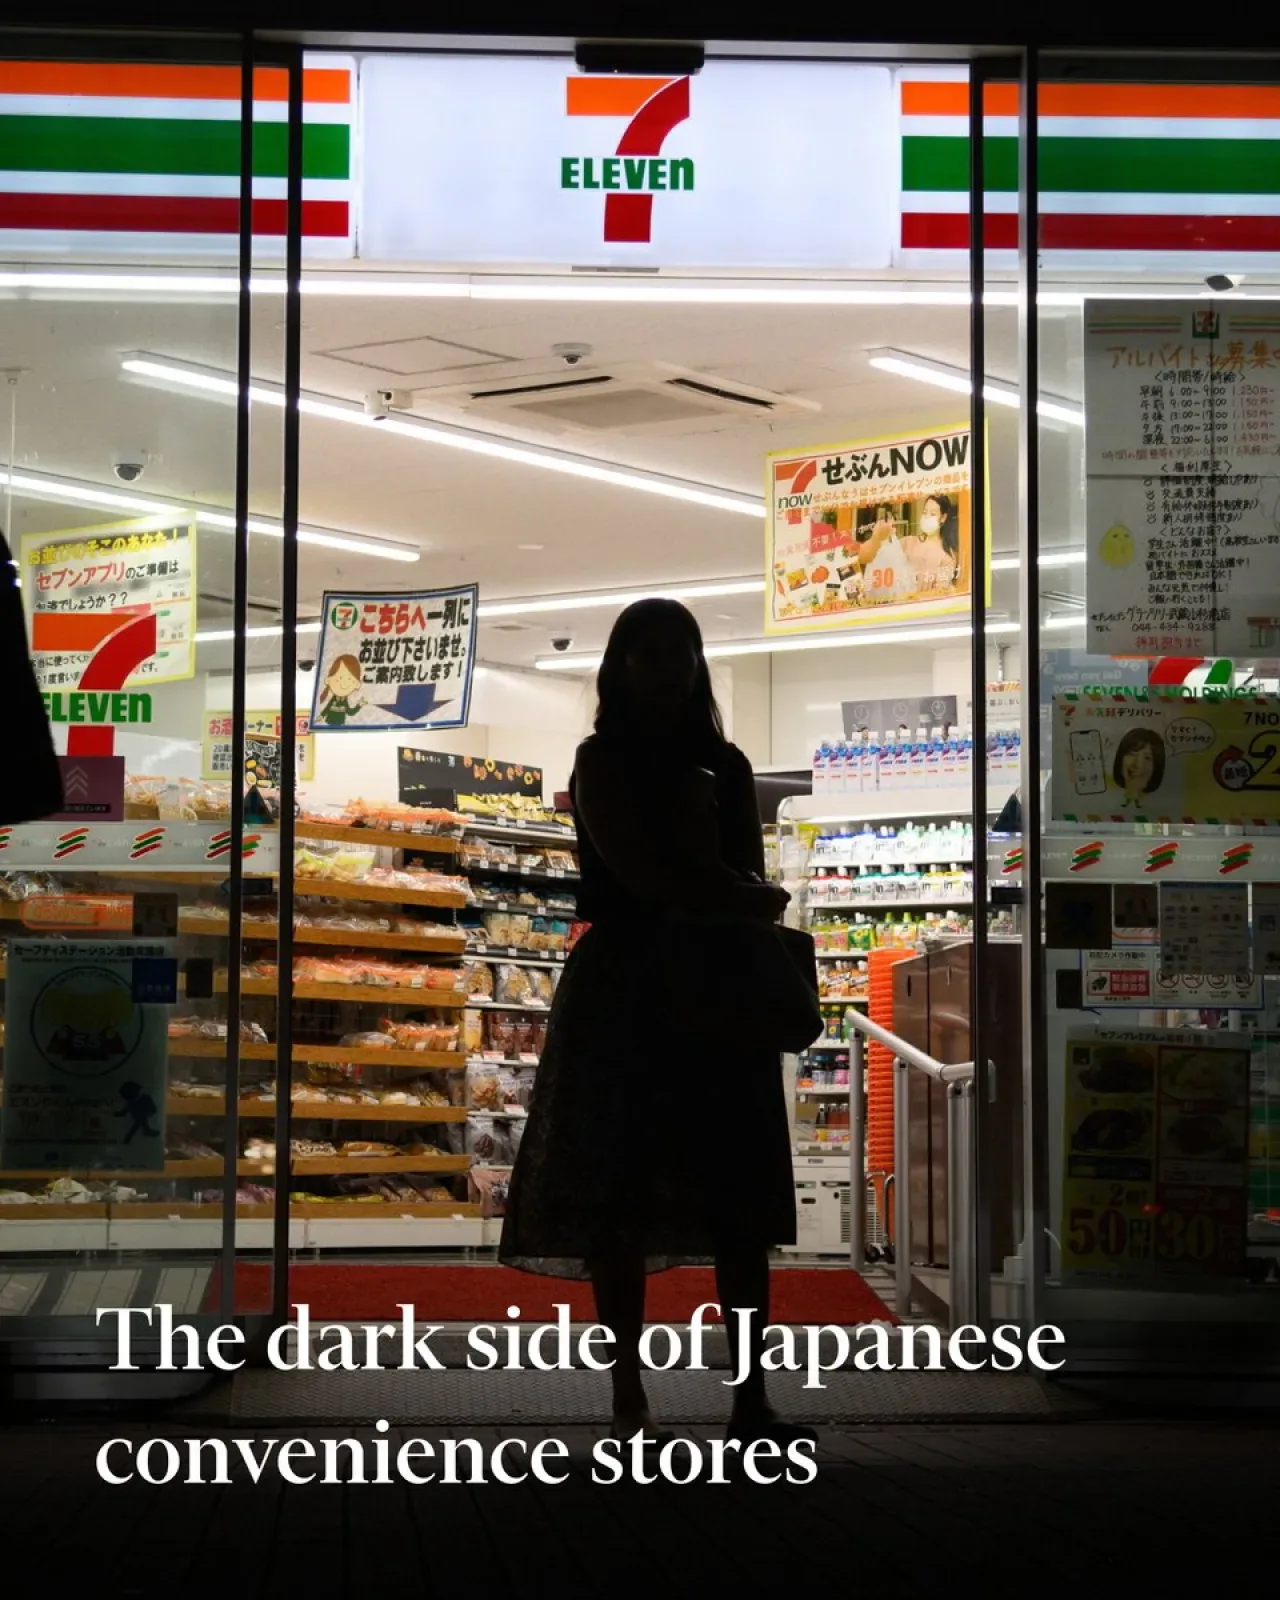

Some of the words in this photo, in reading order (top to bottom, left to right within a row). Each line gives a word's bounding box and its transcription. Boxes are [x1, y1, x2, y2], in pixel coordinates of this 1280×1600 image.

[778, 493, 813, 511] now
[360, 598, 470, 635] こちらへ一列に
[359, 634, 466, 664] お並び下さいませ。
[363, 662, 463, 684] ご案内致します!
